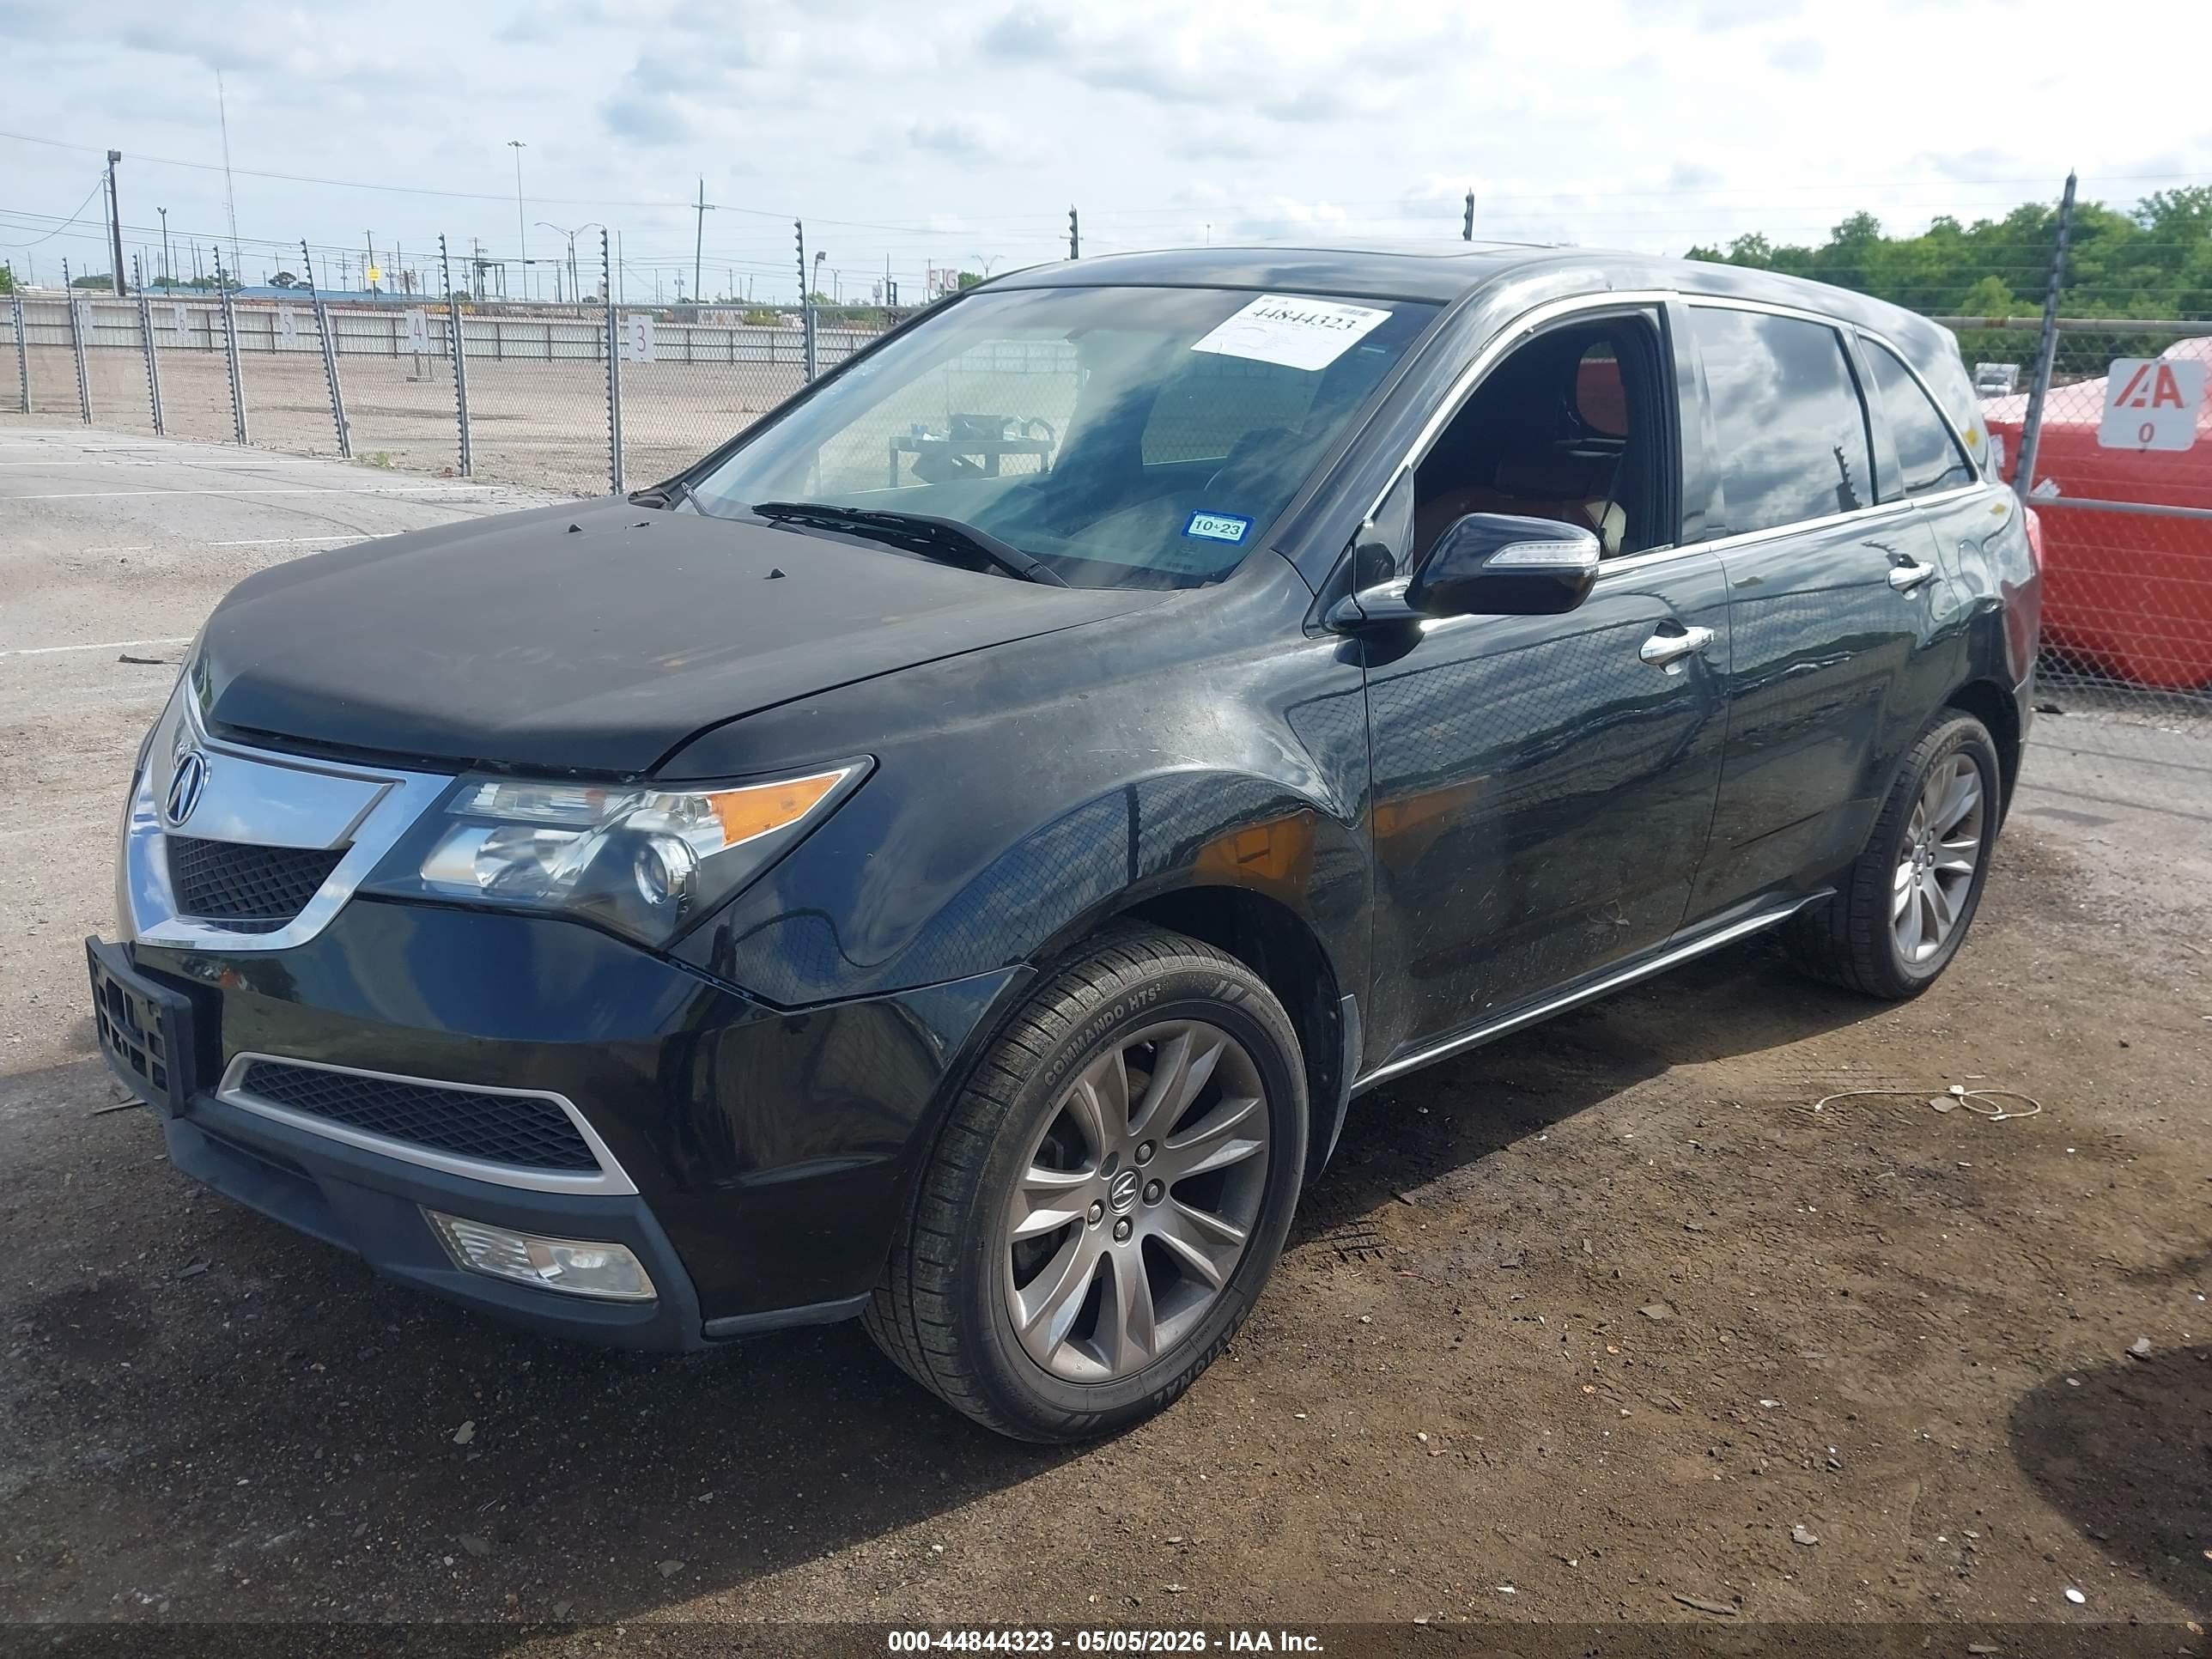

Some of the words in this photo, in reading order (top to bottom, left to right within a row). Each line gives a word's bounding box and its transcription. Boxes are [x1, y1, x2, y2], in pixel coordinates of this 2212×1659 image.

[414, 317, 422, 341] 4
[1252, 307, 1357, 331] 44844323
[637, 324, 647, 352] 3
[1044, 1004, 1125, 1085] COMMANDO
